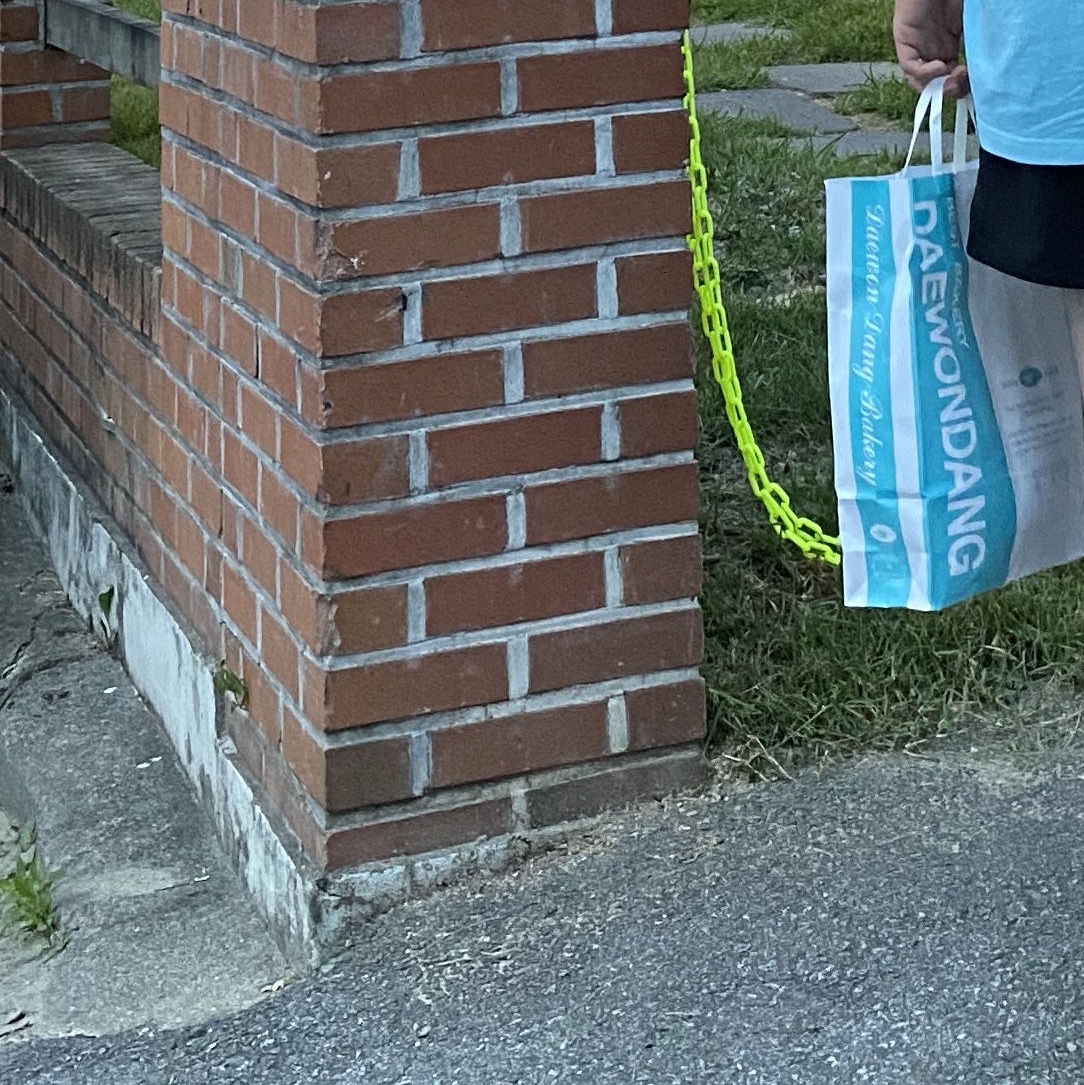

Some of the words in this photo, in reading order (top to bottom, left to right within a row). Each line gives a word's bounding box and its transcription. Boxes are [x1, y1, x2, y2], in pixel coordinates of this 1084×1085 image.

[865, 204, 886, 307] Daewon
[852, 312, 884, 384] Dang
[914, 200, 986, 577] DAEWONDANG
[857, 389, 883, 486] Bakery
